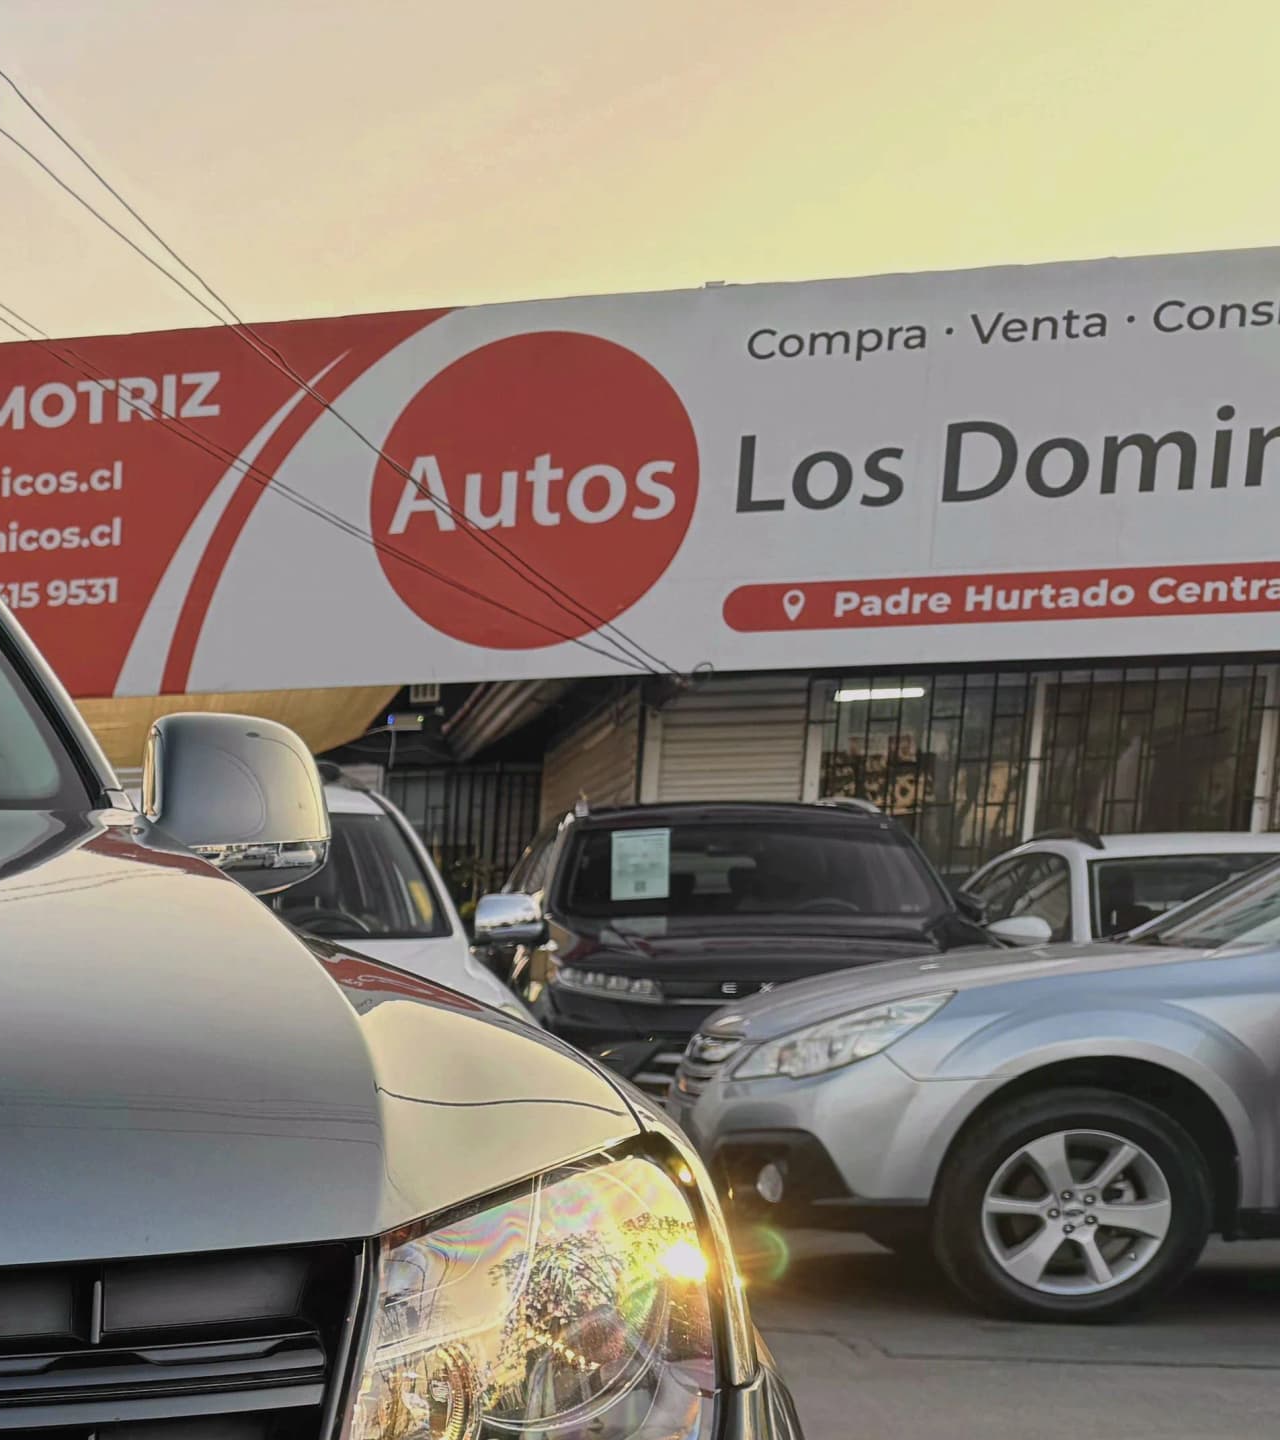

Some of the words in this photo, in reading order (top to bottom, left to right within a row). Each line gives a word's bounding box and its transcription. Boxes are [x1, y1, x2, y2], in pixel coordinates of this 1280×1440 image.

[747, 324, 928, 361] Compra
[970, 309, 1108, 345] Venta
[1153, 300, 1280, 332] Cons
[388, 453, 676, 535] Autos
[736, 434, 905, 513] Los
[46, 577, 119, 607] 9531
[834, 587, 951, 618] Padre
[964, 578, 1135, 612] Hurtado
[1148, 575, 1280, 605] Centra
